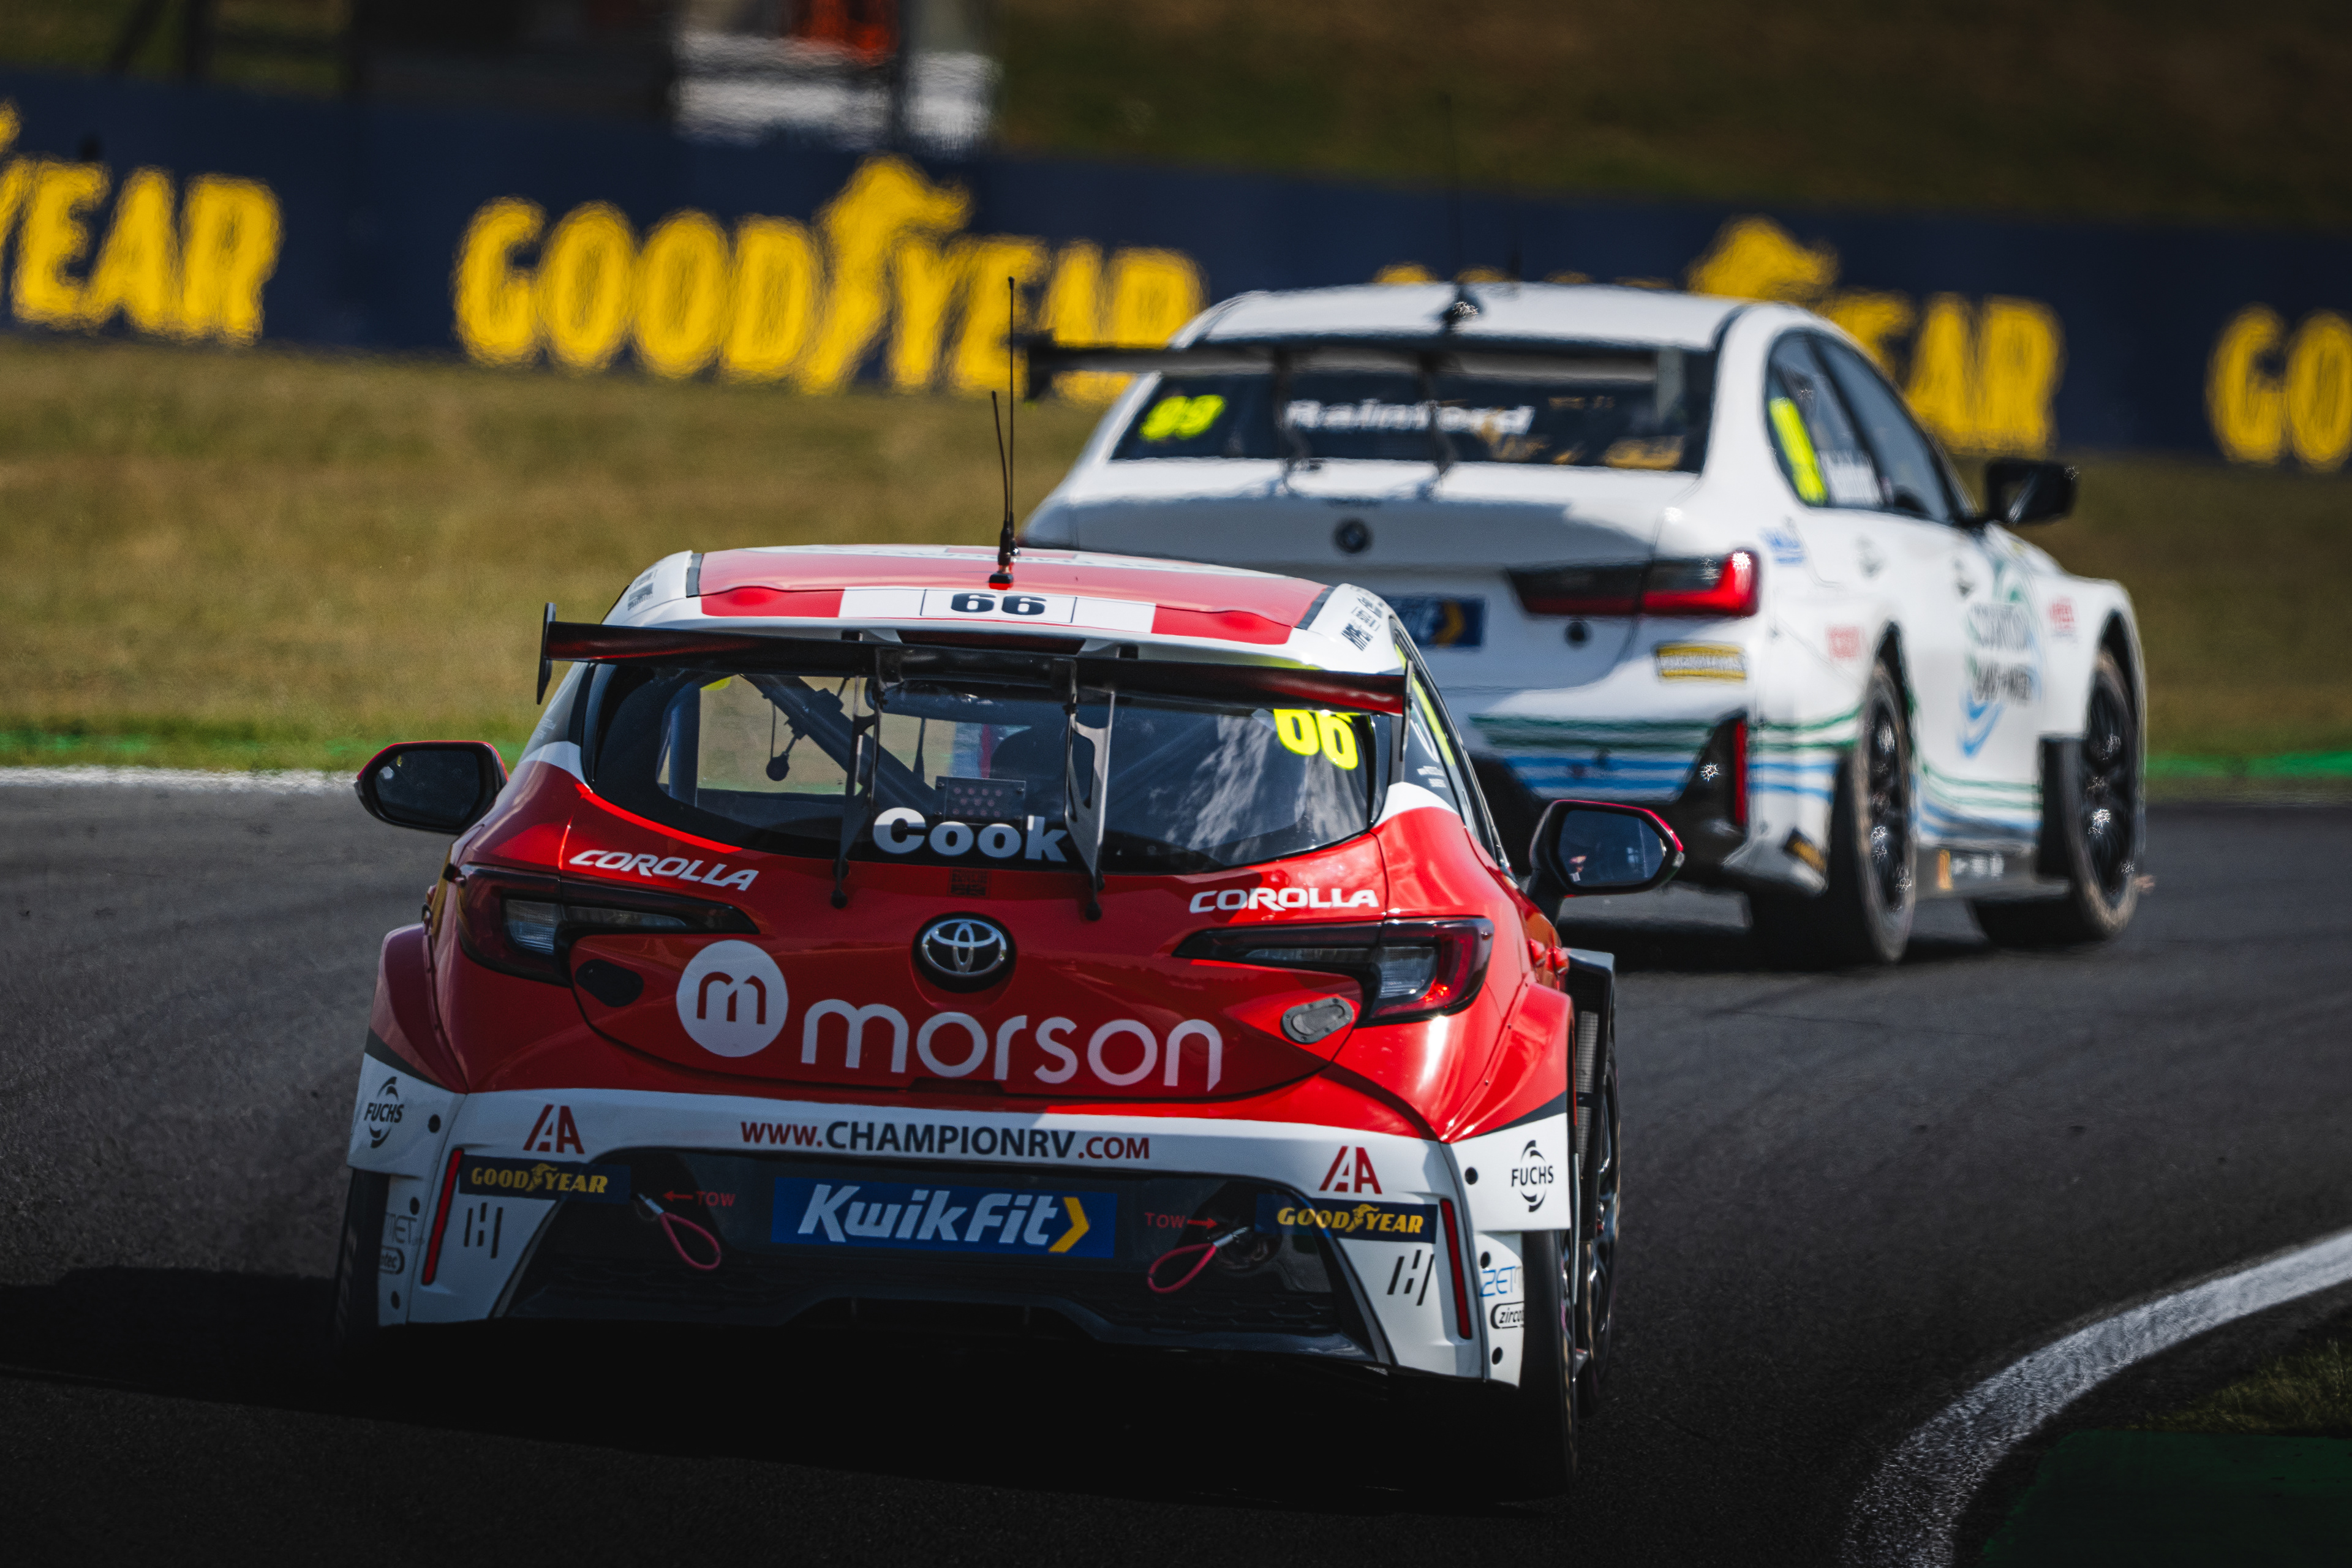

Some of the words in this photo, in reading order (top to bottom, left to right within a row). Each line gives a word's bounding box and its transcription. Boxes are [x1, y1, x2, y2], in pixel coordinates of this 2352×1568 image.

[951, 592, 1047, 616] 66
[872, 807, 1068, 862] Cook
[569, 849, 759, 891] COROLLA
[1189, 887, 1379, 913] COROLLA
[801, 998, 1224, 1093] morson
[364, 1102, 404, 1123] FUCHS
[470, 1164, 608, 1194] GOODYEAR
[1511, 1164, 1554, 1187] FUCHS
[696, 1191, 735, 1207] TOW
[1144, 1212, 1185, 1229] TOW
[1276, 1204, 1424, 1234] GOODYEAR
